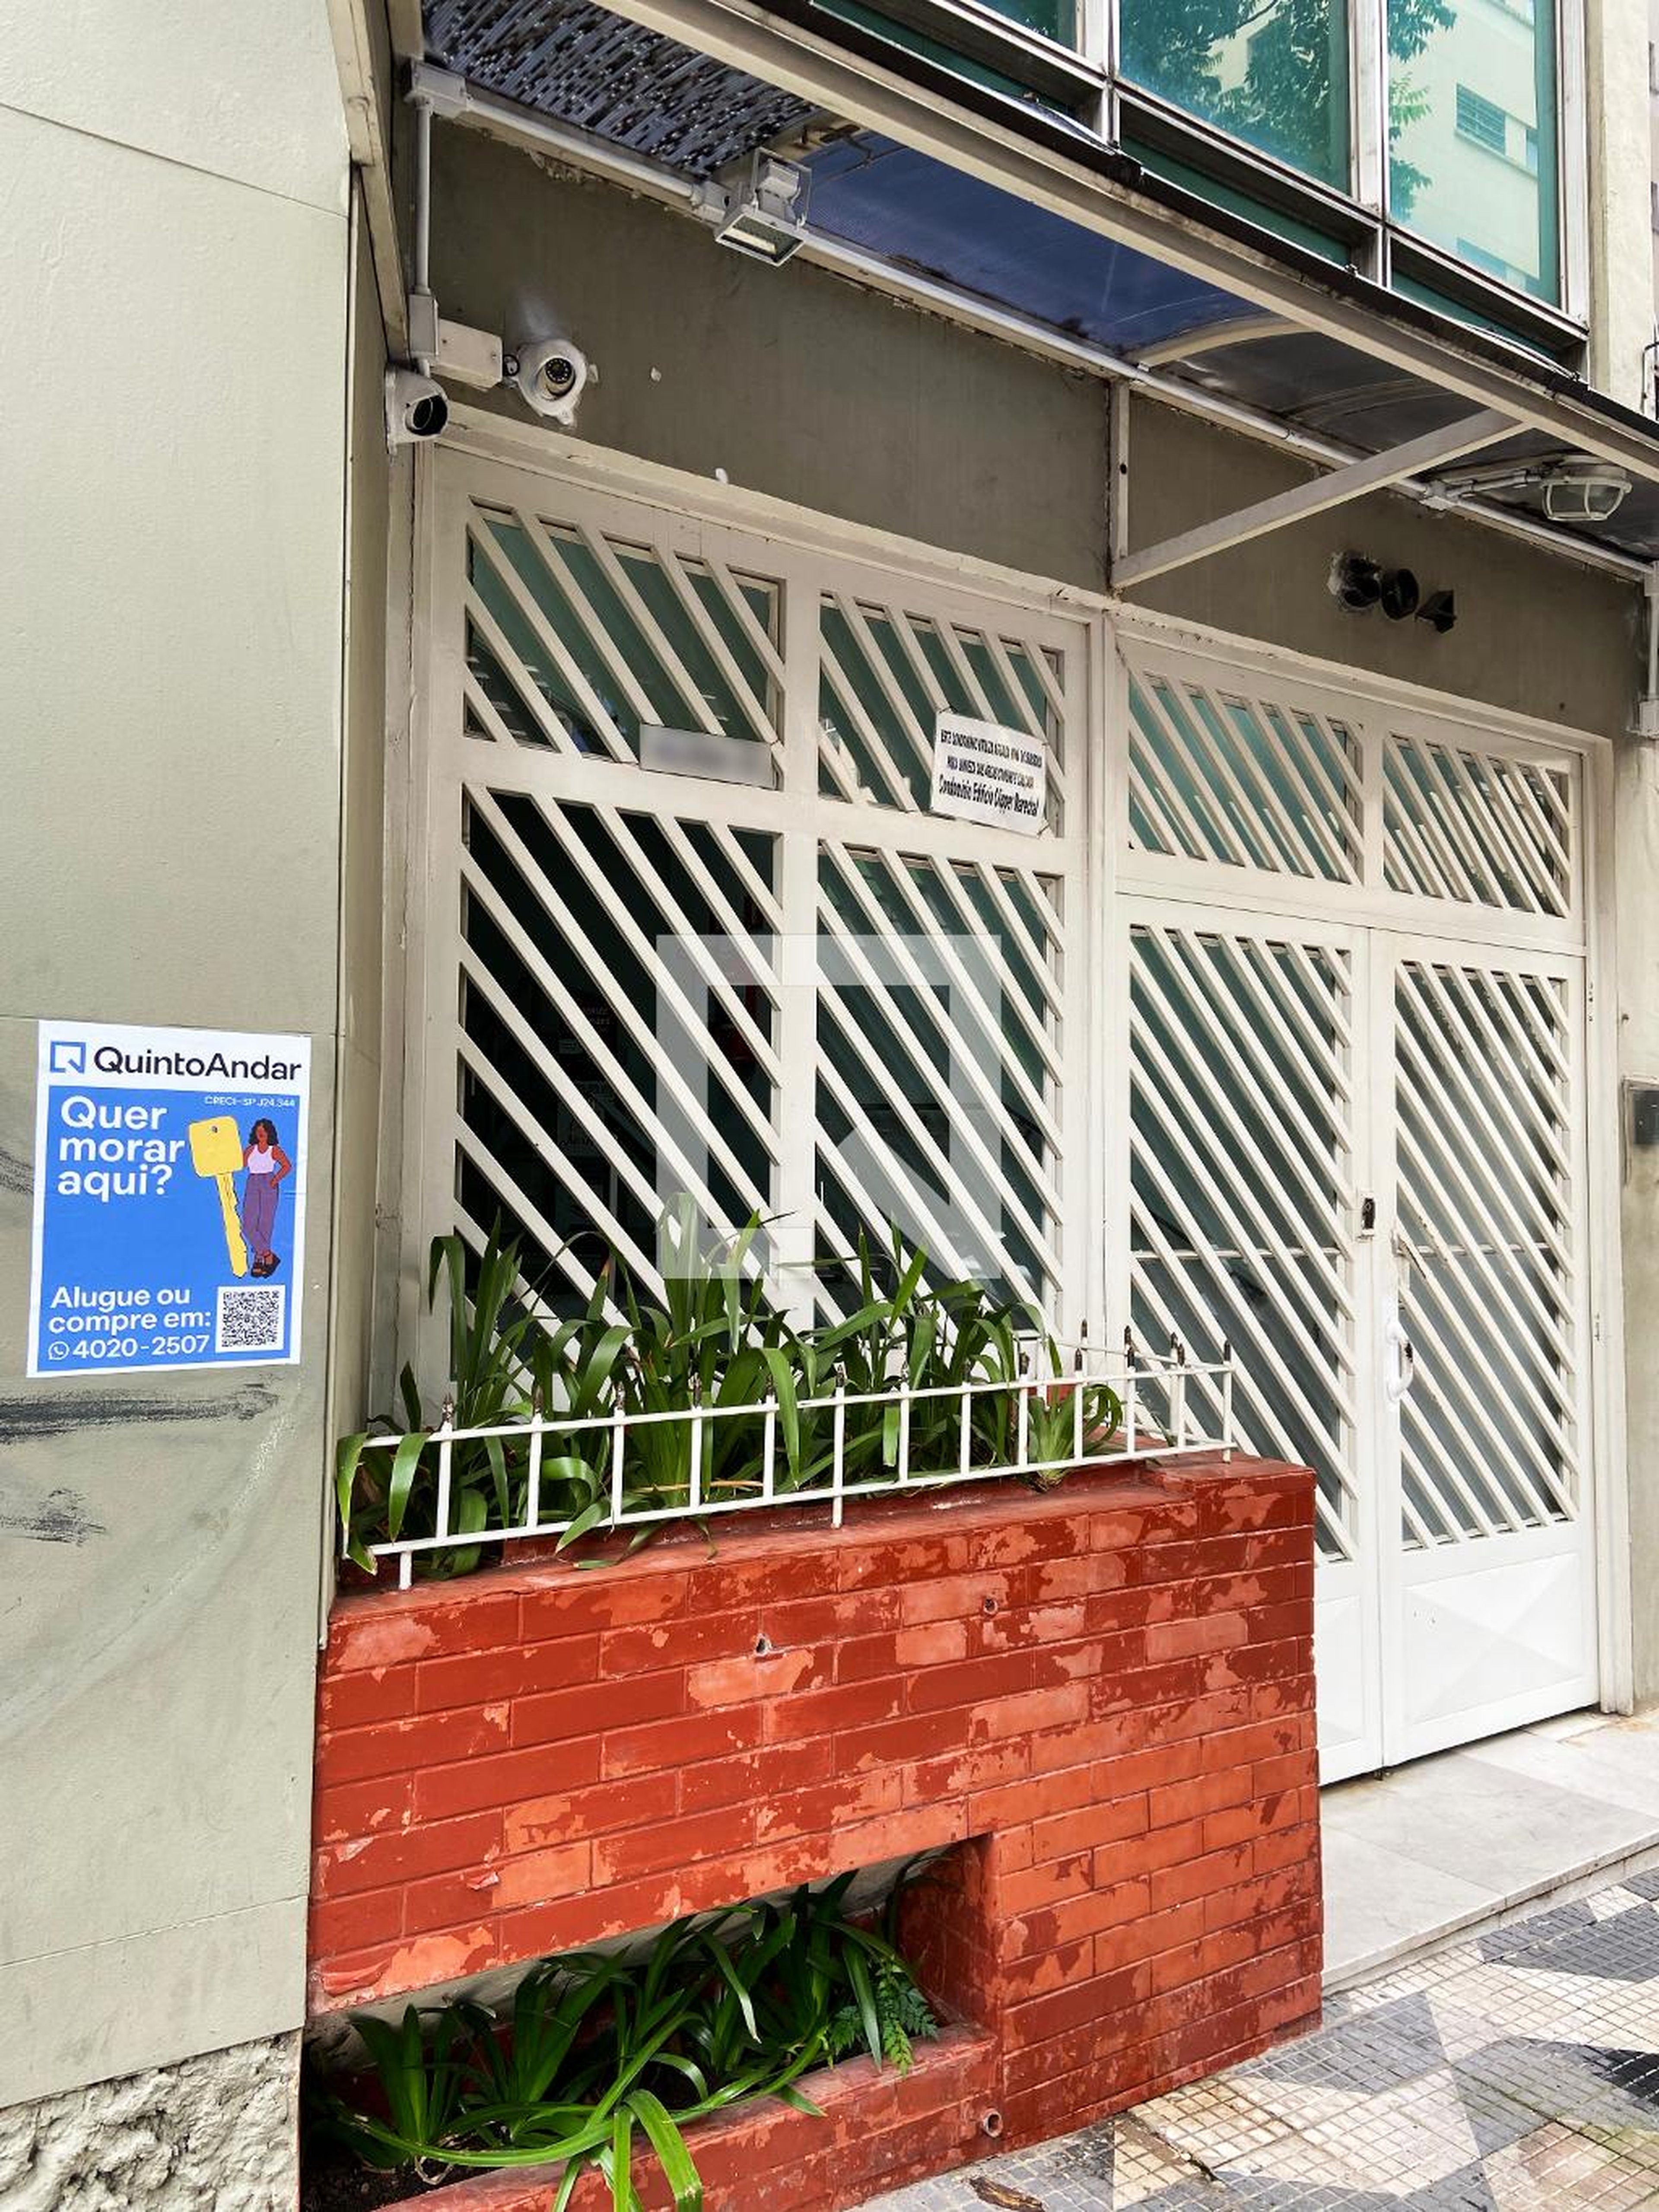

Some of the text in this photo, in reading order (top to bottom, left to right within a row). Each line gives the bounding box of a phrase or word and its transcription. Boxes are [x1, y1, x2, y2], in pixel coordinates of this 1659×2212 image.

[94, 1046, 301, 1080] QuintoAndar
[61, 1095, 167, 1129] Quer
[60, 1134, 185, 1162] morar
[57, 1164, 172, 1202] aqui?
[51, 1286, 190, 1312] Alugue ou
[49, 1311, 211, 1335] compre em:
